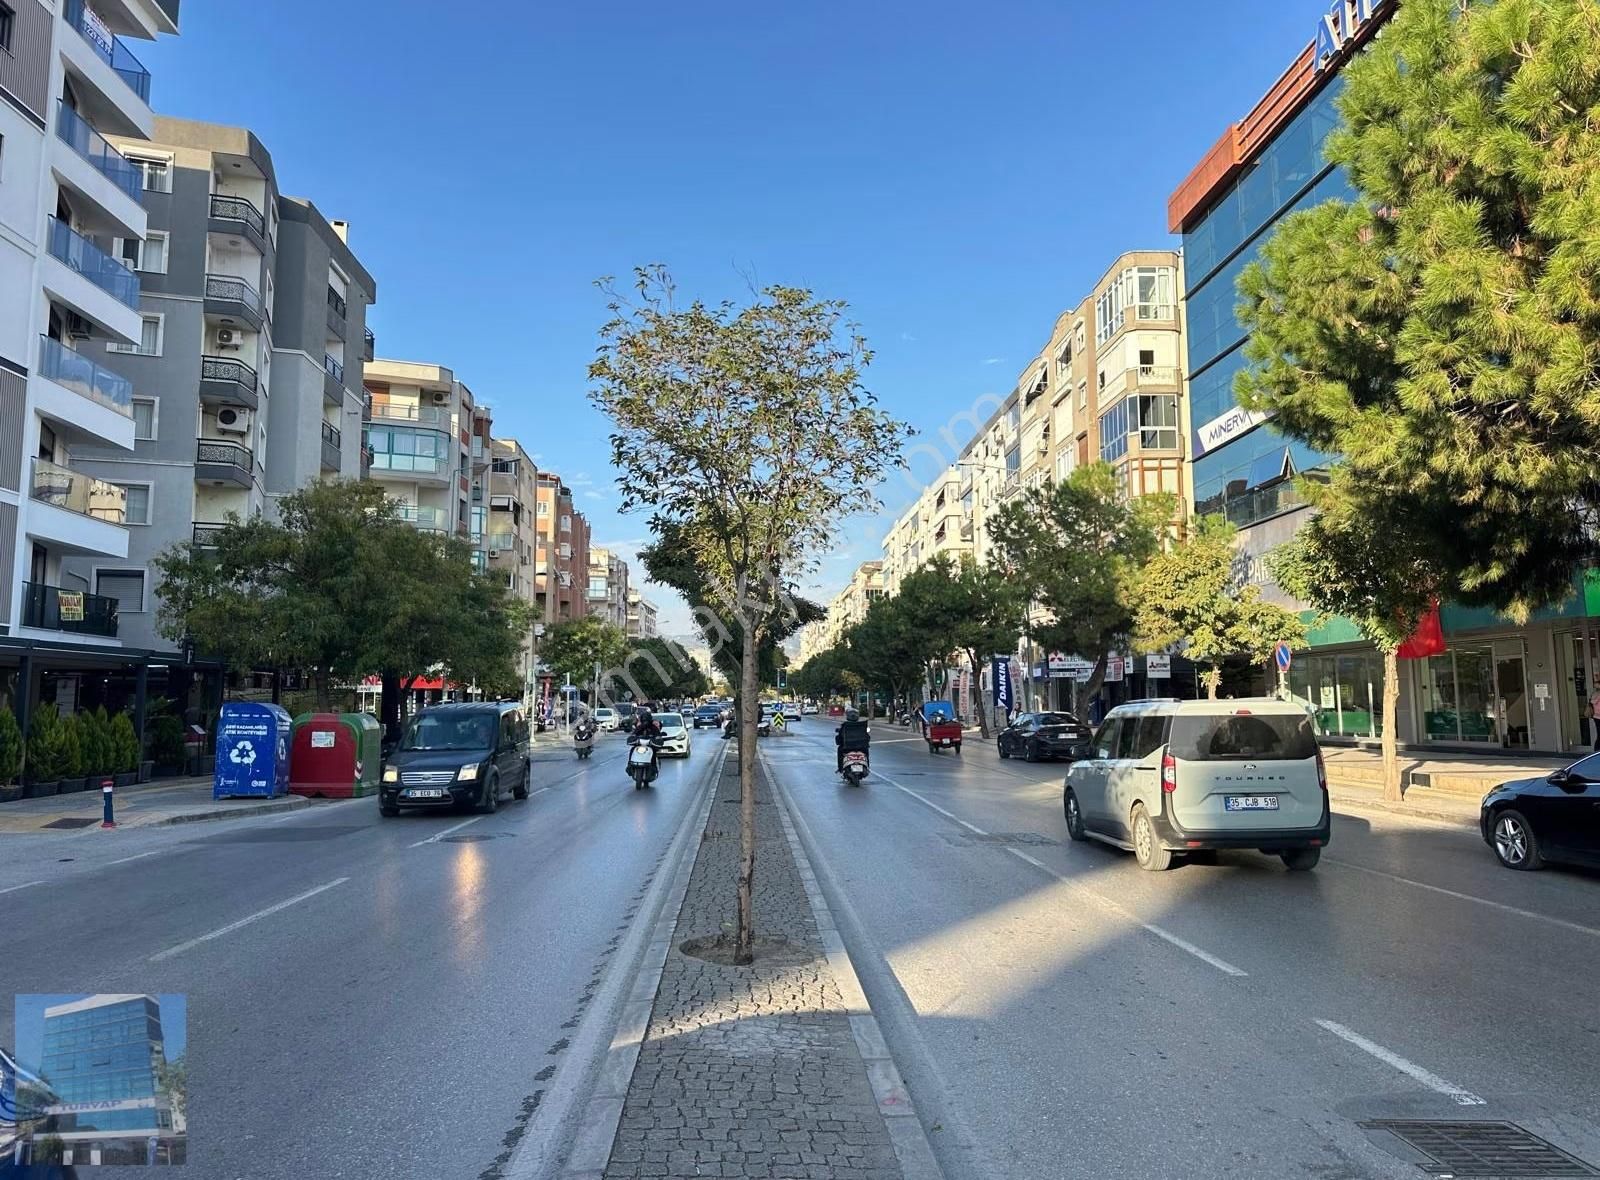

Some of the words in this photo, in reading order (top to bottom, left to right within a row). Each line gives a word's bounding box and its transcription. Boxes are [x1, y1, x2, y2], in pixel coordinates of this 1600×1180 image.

[1209, 409, 1253, 443] MINERVA
[998, 662, 1007, 700] DAIKIN
[1230, 798, 1240, 807] 35
[1245, 798, 1259, 807] CJB
